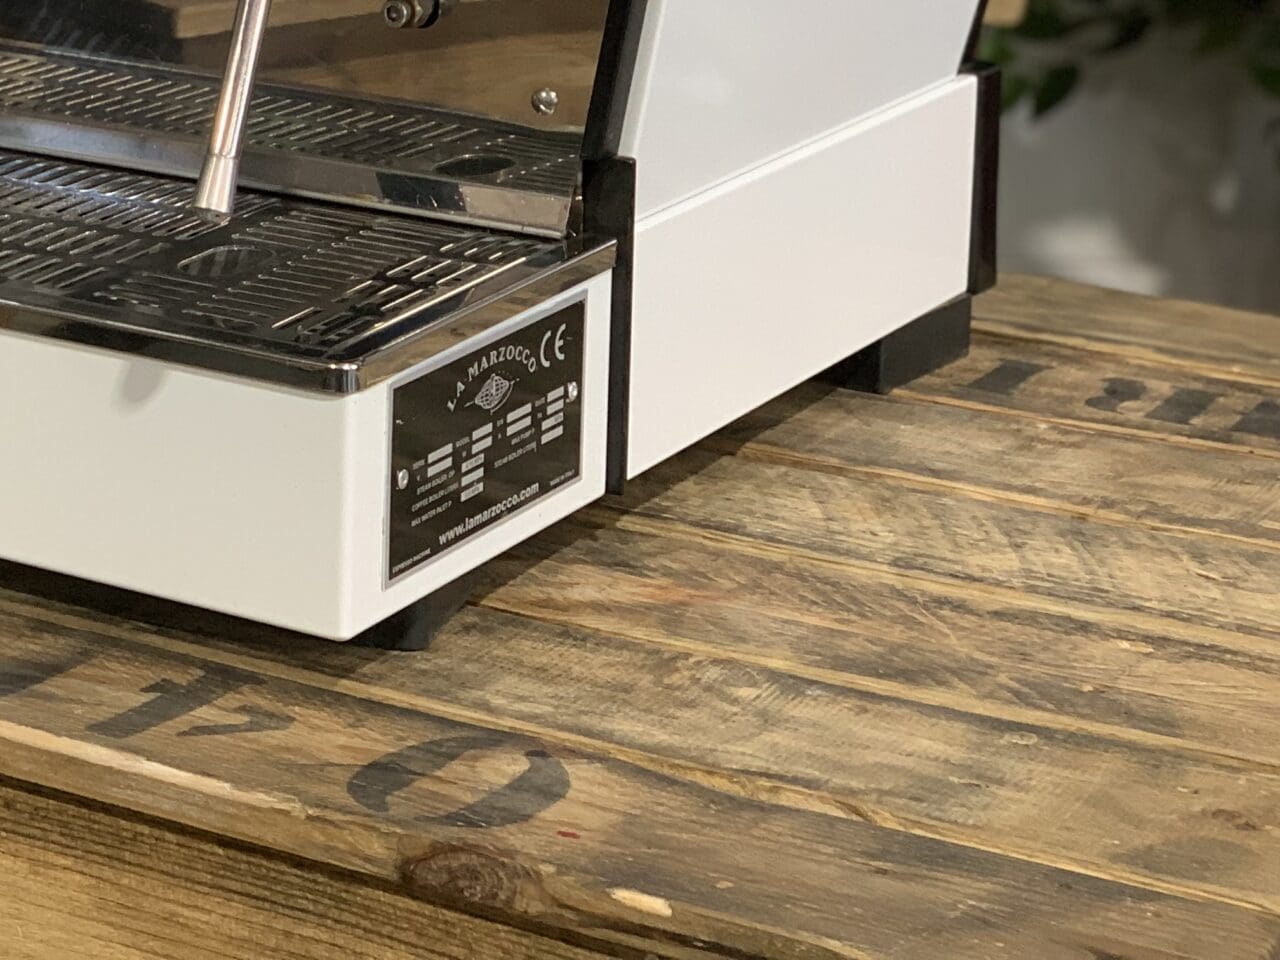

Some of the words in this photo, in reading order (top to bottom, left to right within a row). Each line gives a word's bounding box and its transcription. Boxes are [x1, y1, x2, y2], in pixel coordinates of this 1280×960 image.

[446, 381, 466, 412] LA
[466, 344, 537, 383] MARZOCCO
[438, 483, 540, 545] www.lamarzocco.com
